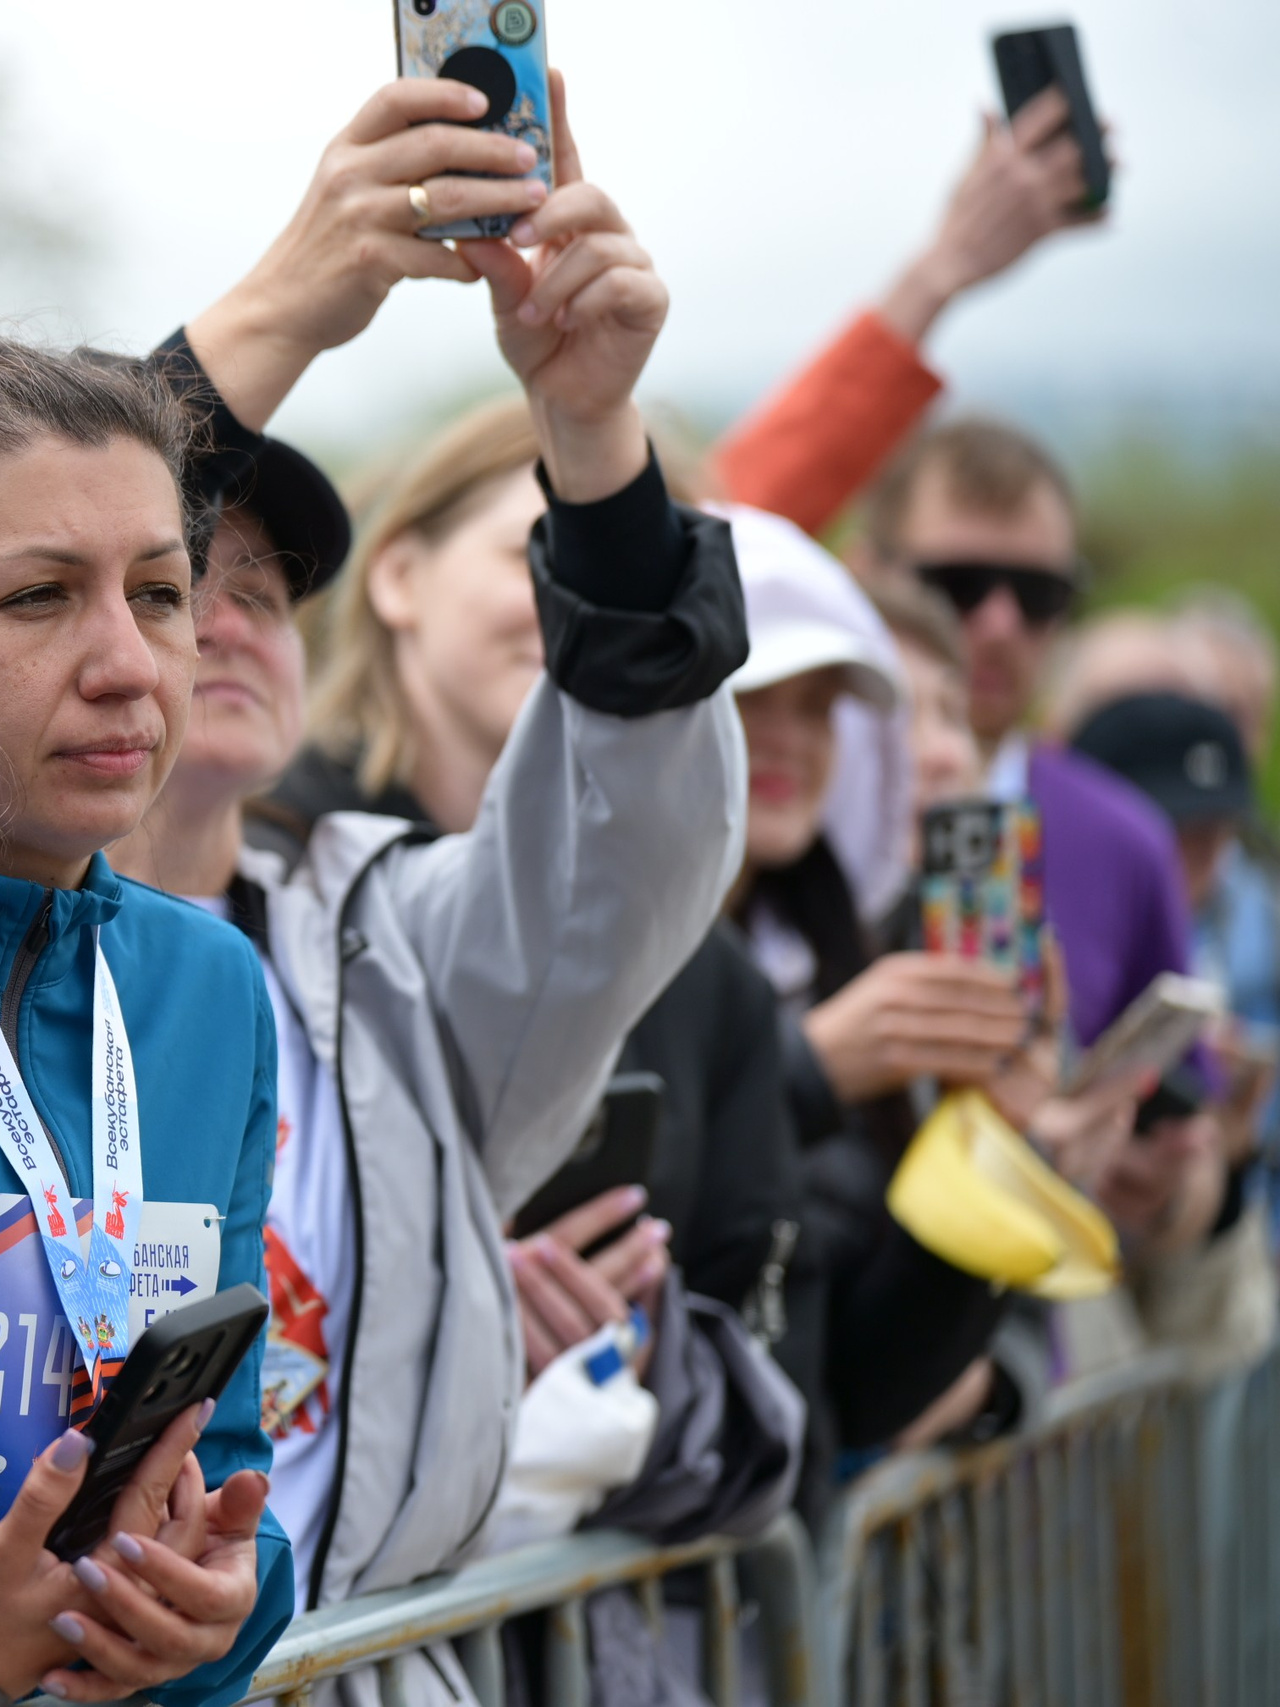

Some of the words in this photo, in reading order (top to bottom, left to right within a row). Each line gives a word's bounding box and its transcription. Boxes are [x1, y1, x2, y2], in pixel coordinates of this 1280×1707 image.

[104, 1018, 117, 1169] Всекубанская
[114, 1046, 128, 1151] эстафета
[129, 1273, 159, 1297] ФЕТА
[134, 1243, 189, 1268] БАНСКАЯ
